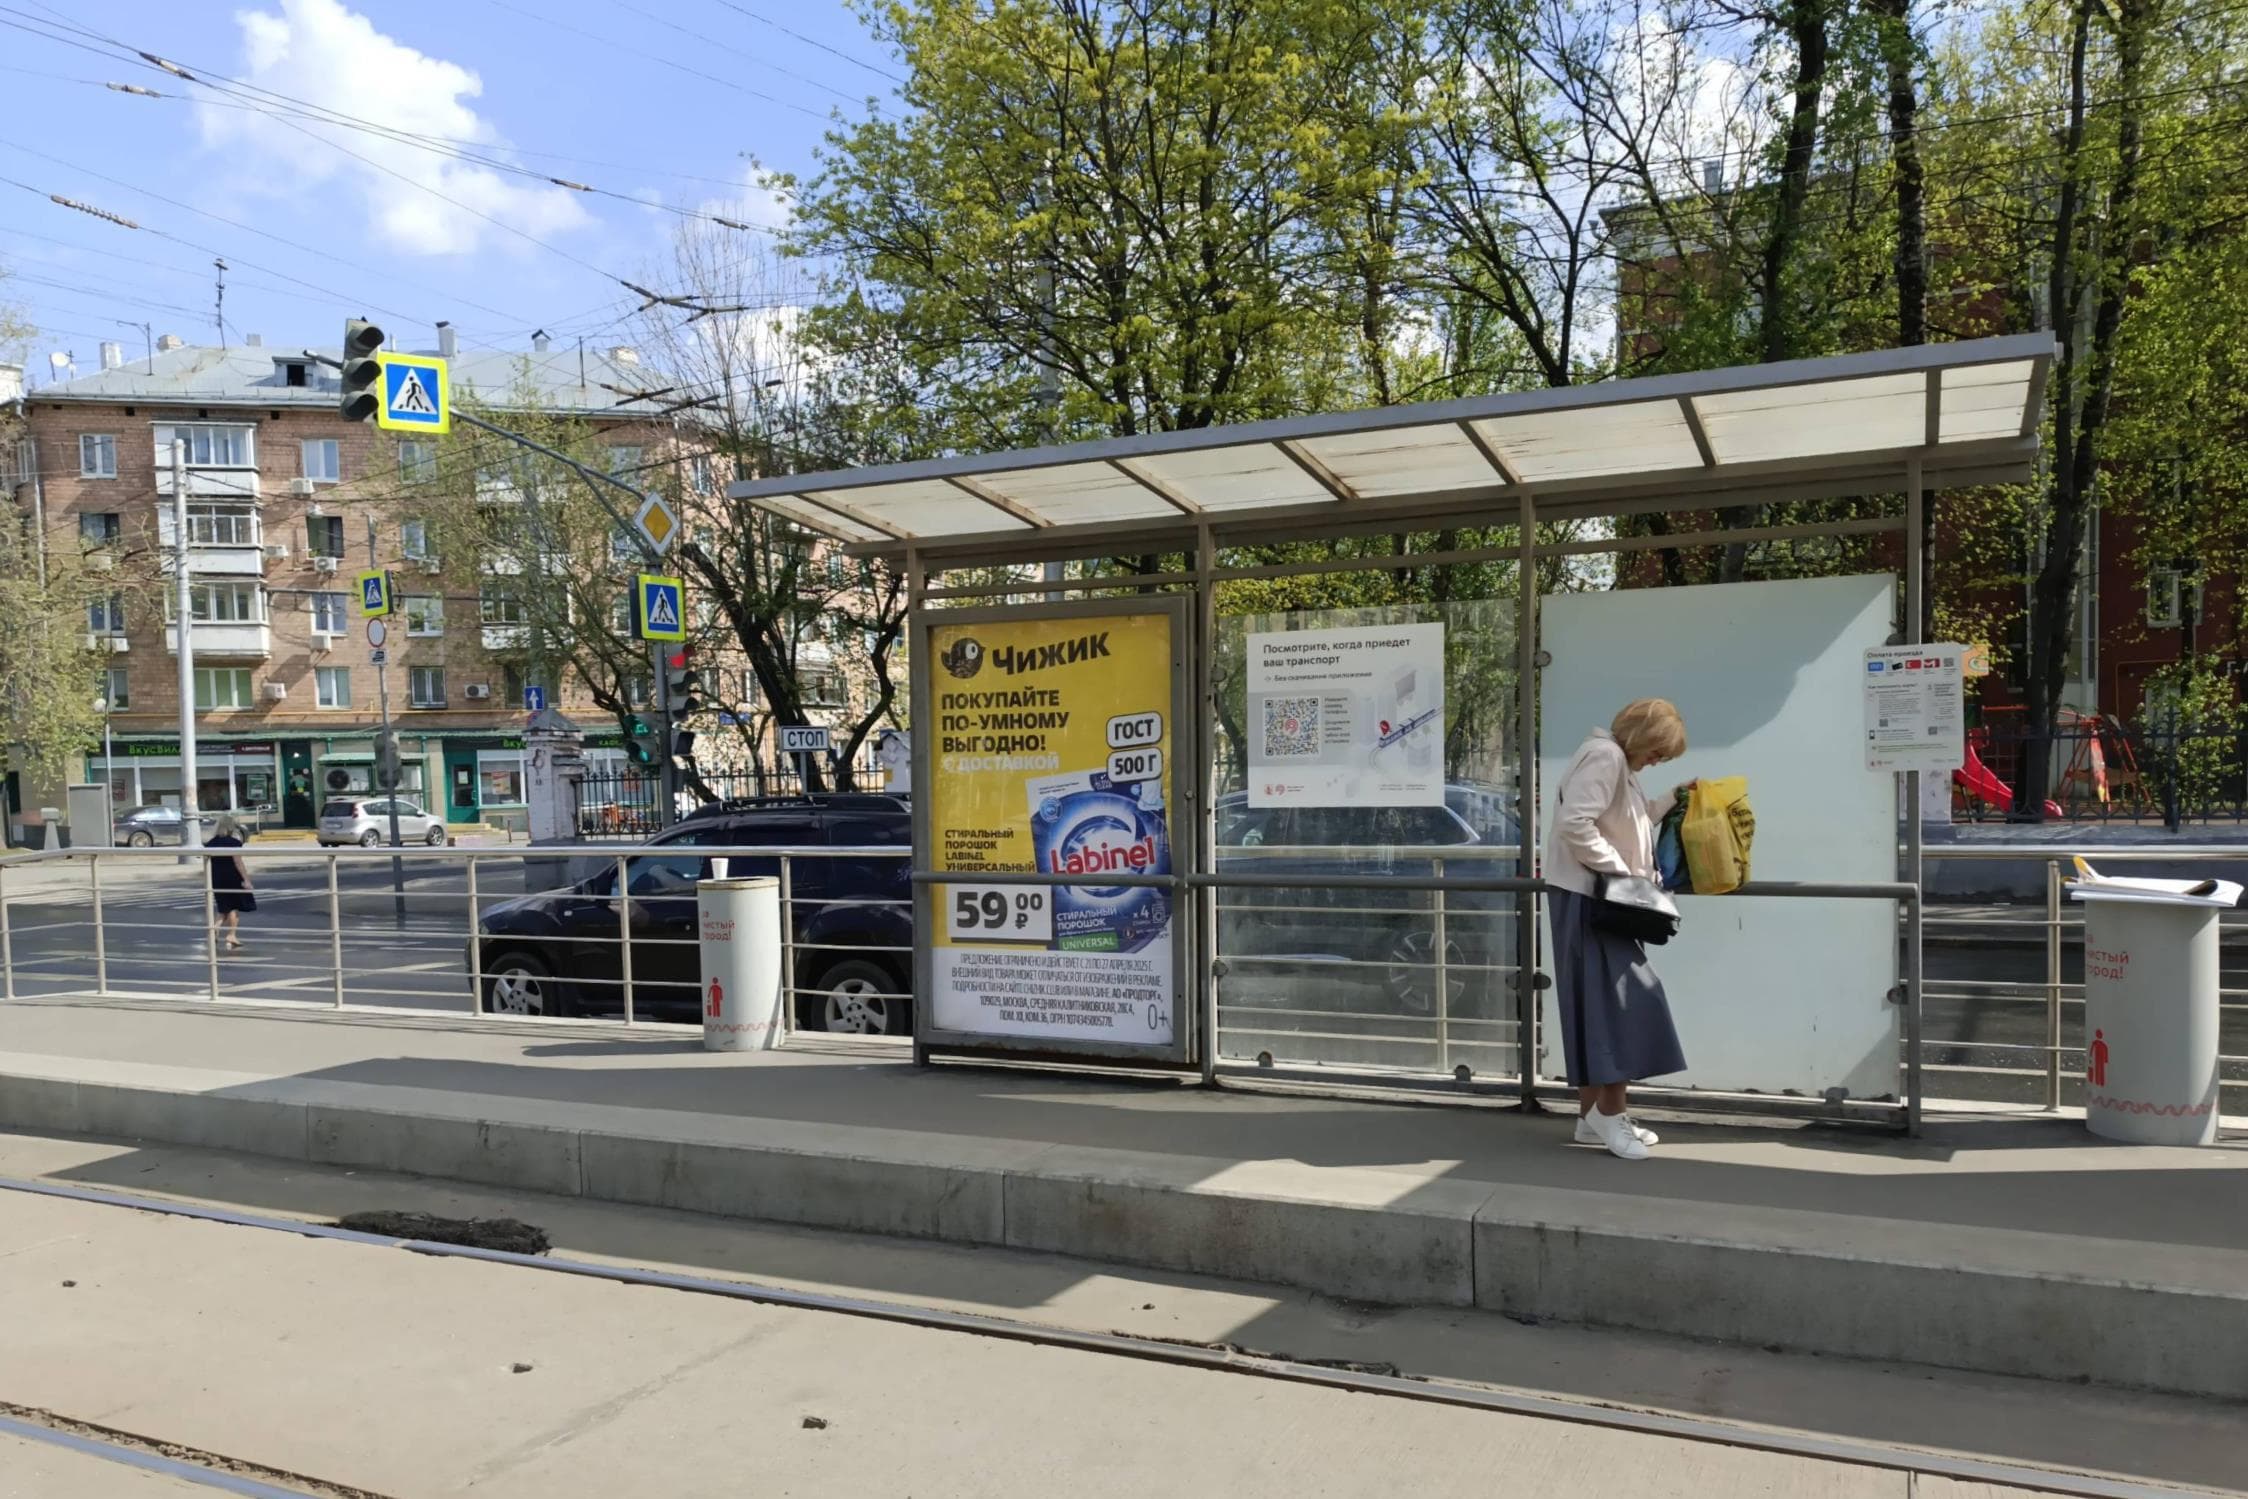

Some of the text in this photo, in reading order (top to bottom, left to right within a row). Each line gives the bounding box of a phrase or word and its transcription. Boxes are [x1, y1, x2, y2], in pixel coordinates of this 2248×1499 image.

[1263, 638, 1411, 654] Посмотрите, когда приедет
[1263, 655, 1341, 668] ваш транспорт
[942, 686, 1060, 710] ПОКУПАЙТЕ
[942, 712, 1070, 732] ПО-УМНОМУ
[1114, 719, 1155, 741] ГОСТ
[787, 730, 824, 747] СТОП
[942, 735, 1046, 755] ВЫГОДНО!
[129, 744, 184, 756] ВкусВил
[957, 752, 1060, 772] ДОСТАВКОЙ
[1114, 755, 1157, 776] 500 Г
[944, 828, 1014, 839] СТИРАЛЬНЫЙ
[945, 841, 998, 850] ПОРОШОК
[945, 852, 986, 861] LABINEL
[1051, 837, 1156, 875] Labinel
[945, 861, 1036, 872] УНИВЕРСАЛЬНЫЙ
[956, 891, 1043, 930] 59 00
[1056, 906, 1117, 921] СТИРАЛЬНЫЙ
[1057, 918, 1107, 930] ПОРОШОК
[1062, 937, 1114, 950] UNIVERSAL
[1148, 1004, 1168, 1030] 0+
